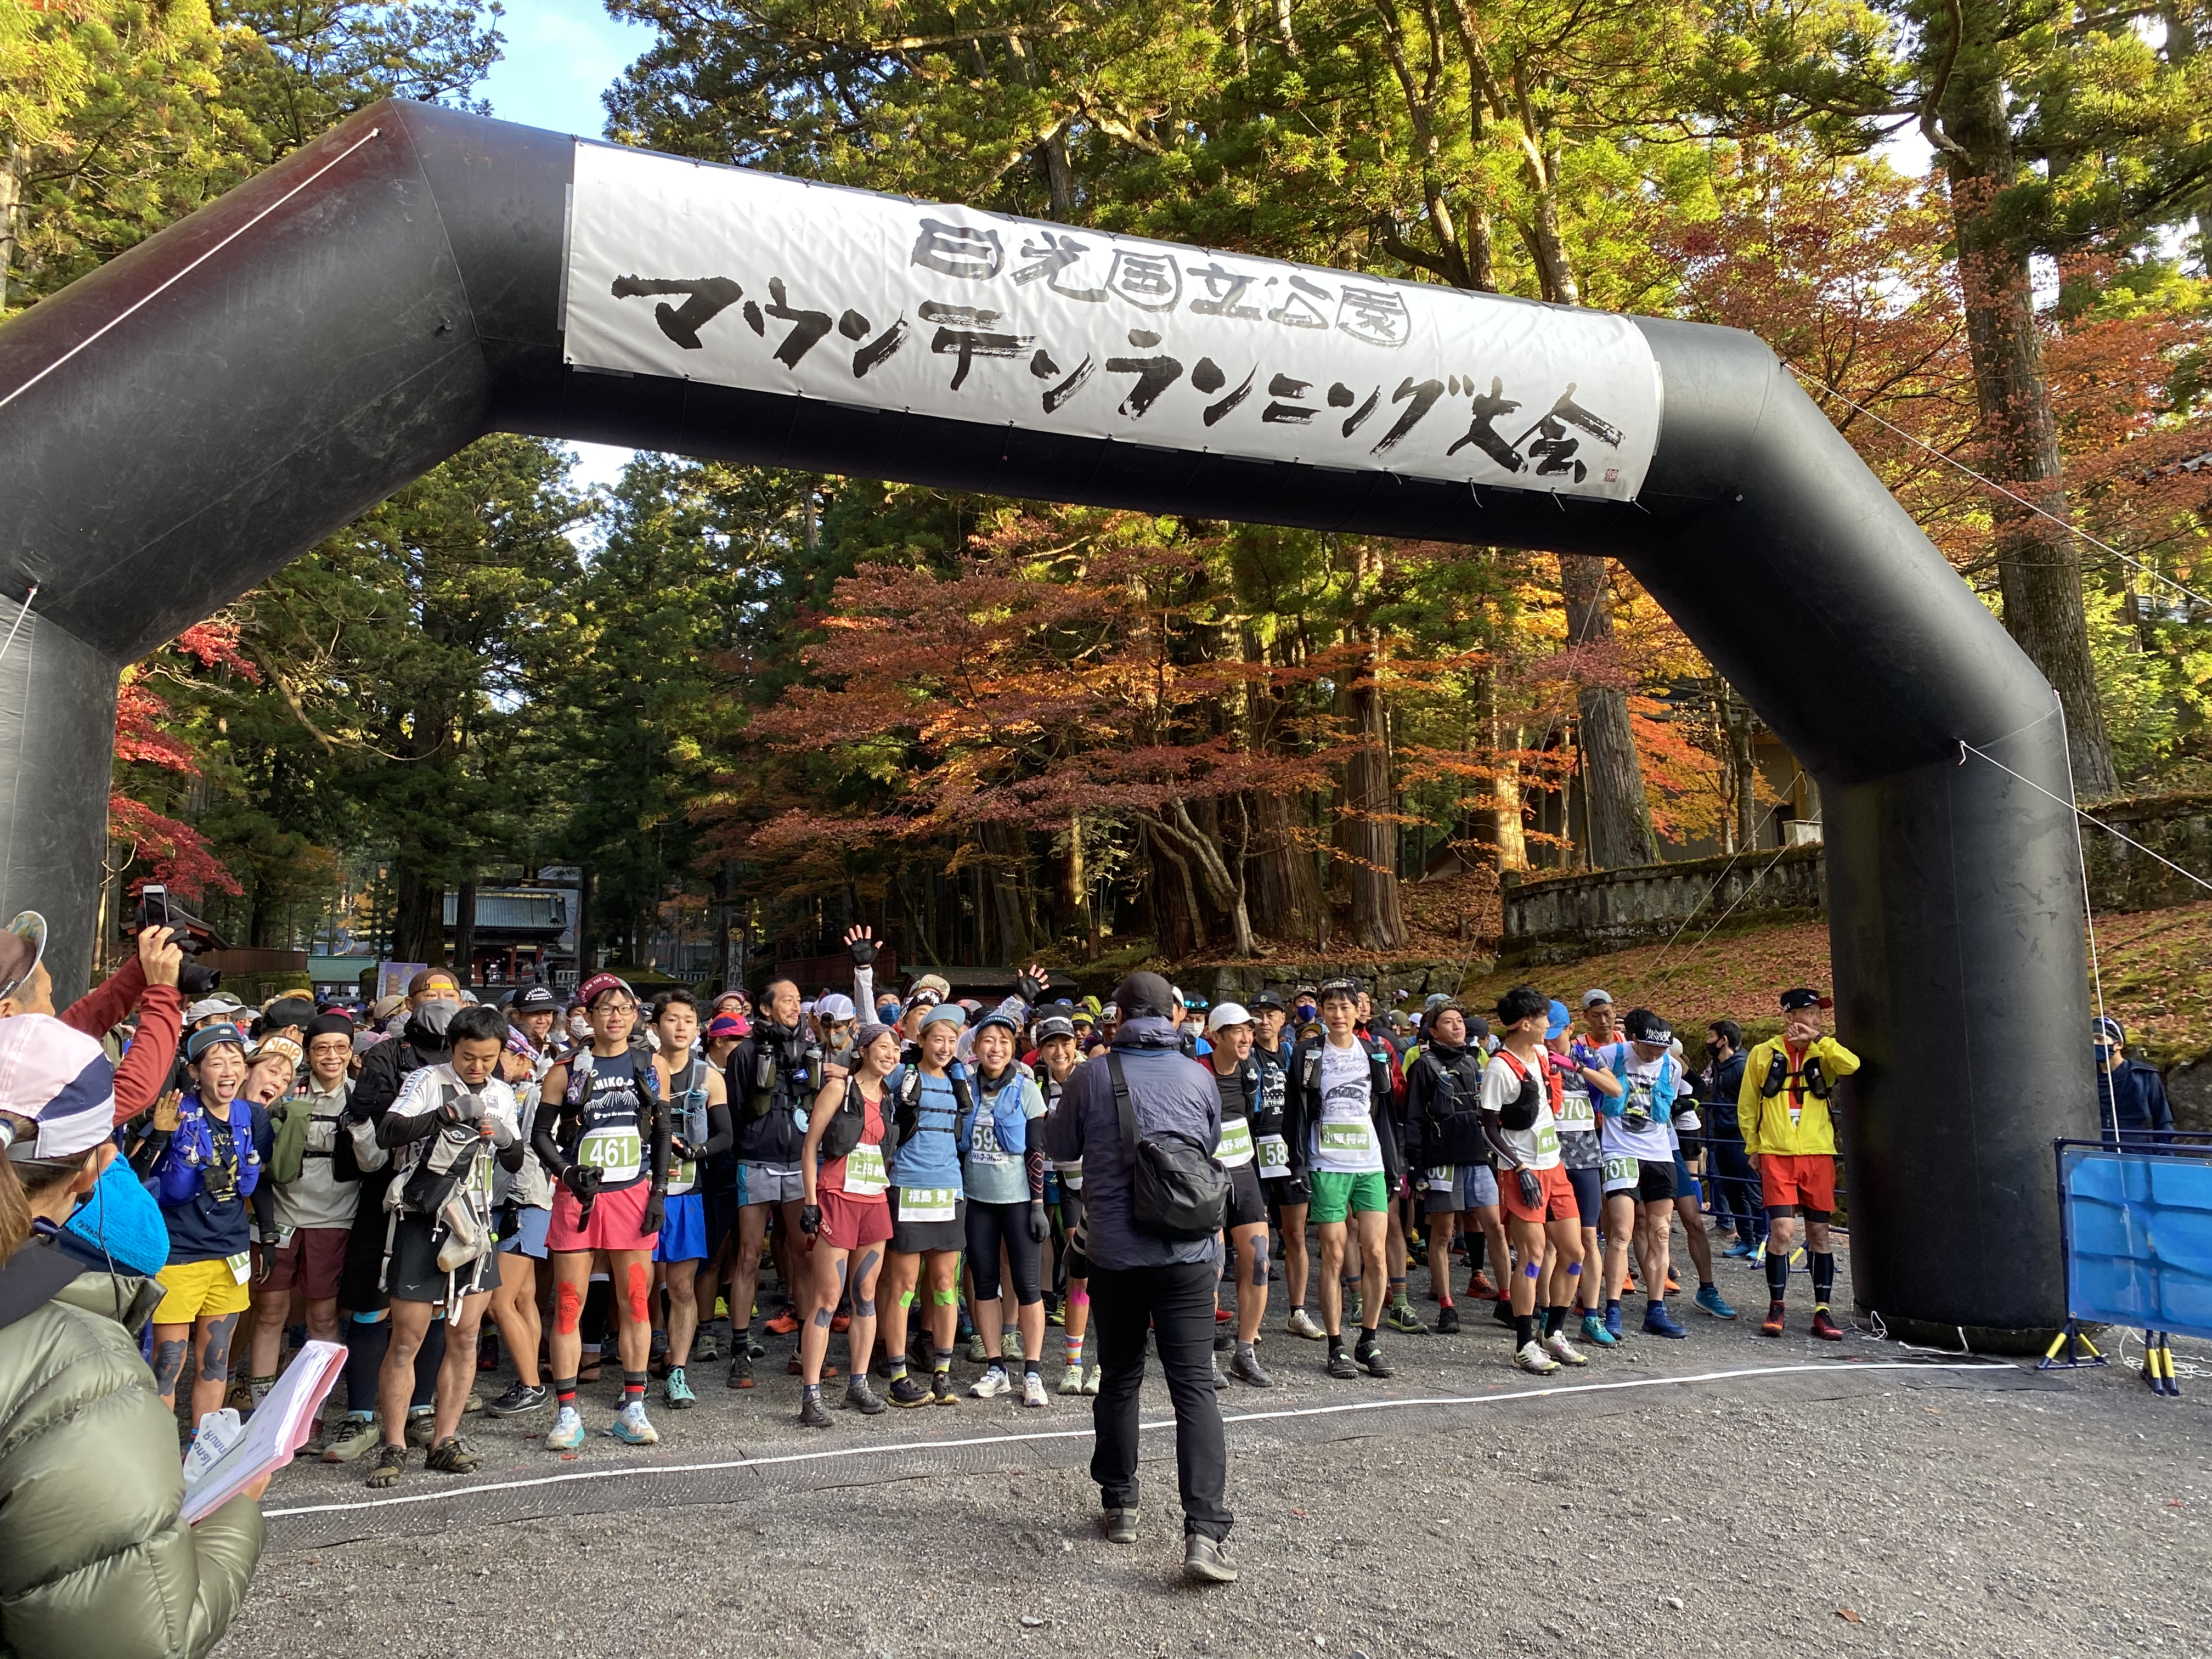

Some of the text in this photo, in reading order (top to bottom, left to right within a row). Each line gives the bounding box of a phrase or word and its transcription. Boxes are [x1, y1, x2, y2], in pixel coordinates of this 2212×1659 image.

[911, 218, 1411, 347] 日光国立公園
[611, 274, 1626, 484] マウンテンランニング大会
[593, 977, 602, 985] THE
[603, 976, 617, 984] WAY
[263, 1037, 302, 1062] ciele
[589, 1137, 629, 1167] 461
[909, 1189, 933, 1203] 福島
